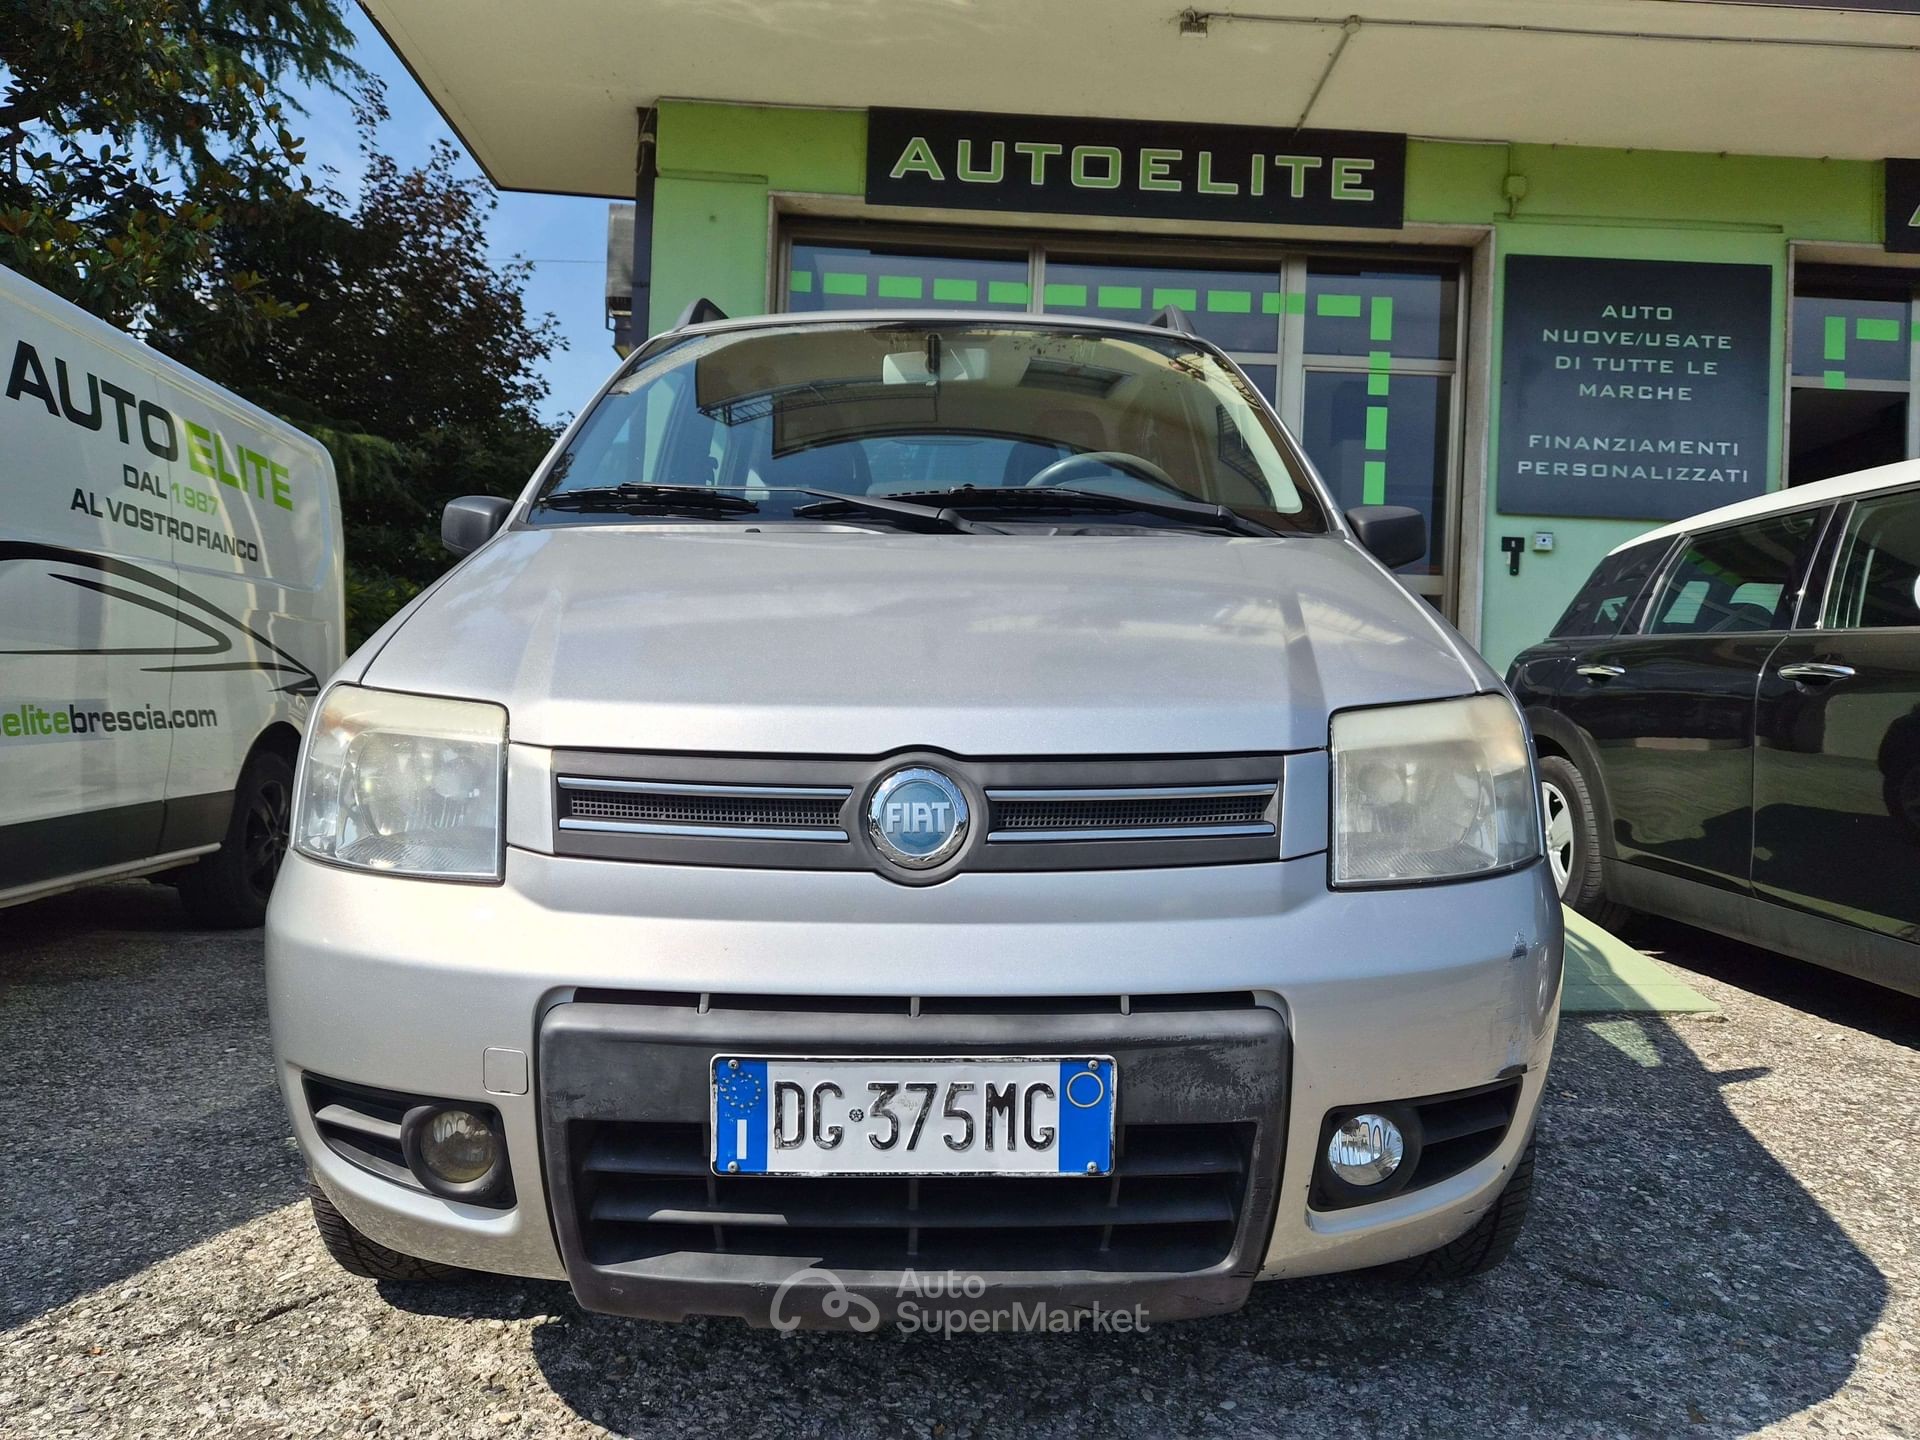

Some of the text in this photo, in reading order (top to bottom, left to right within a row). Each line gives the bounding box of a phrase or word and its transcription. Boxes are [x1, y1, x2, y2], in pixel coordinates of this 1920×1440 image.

[889, 136, 1375, 201] AUTOELITE
[1601, 304, 1673, 321] AUTO
[1542, 328, 1732, 350] NUOVE/USATE
[1555, 355, 1718, 376] DI TUTTE LE
[1579, 383, 1692, 401] MARCHE
[1528, 434, 1739, 457] FINANZIAMENTI
[1517, 460, 1748, 483] PERSONALIZZATI
[123, 464, 218, 516] DAL 1987
[71, 488, 258, 562] AL VOSTRO FIANCO
[0, 704, 218, 737] elitebrescia.com
[886, 802, 950, 833] FIAT
[774, 1081, 843, 1151] DG
[867, 1082, 1055, 1151] 375MG
